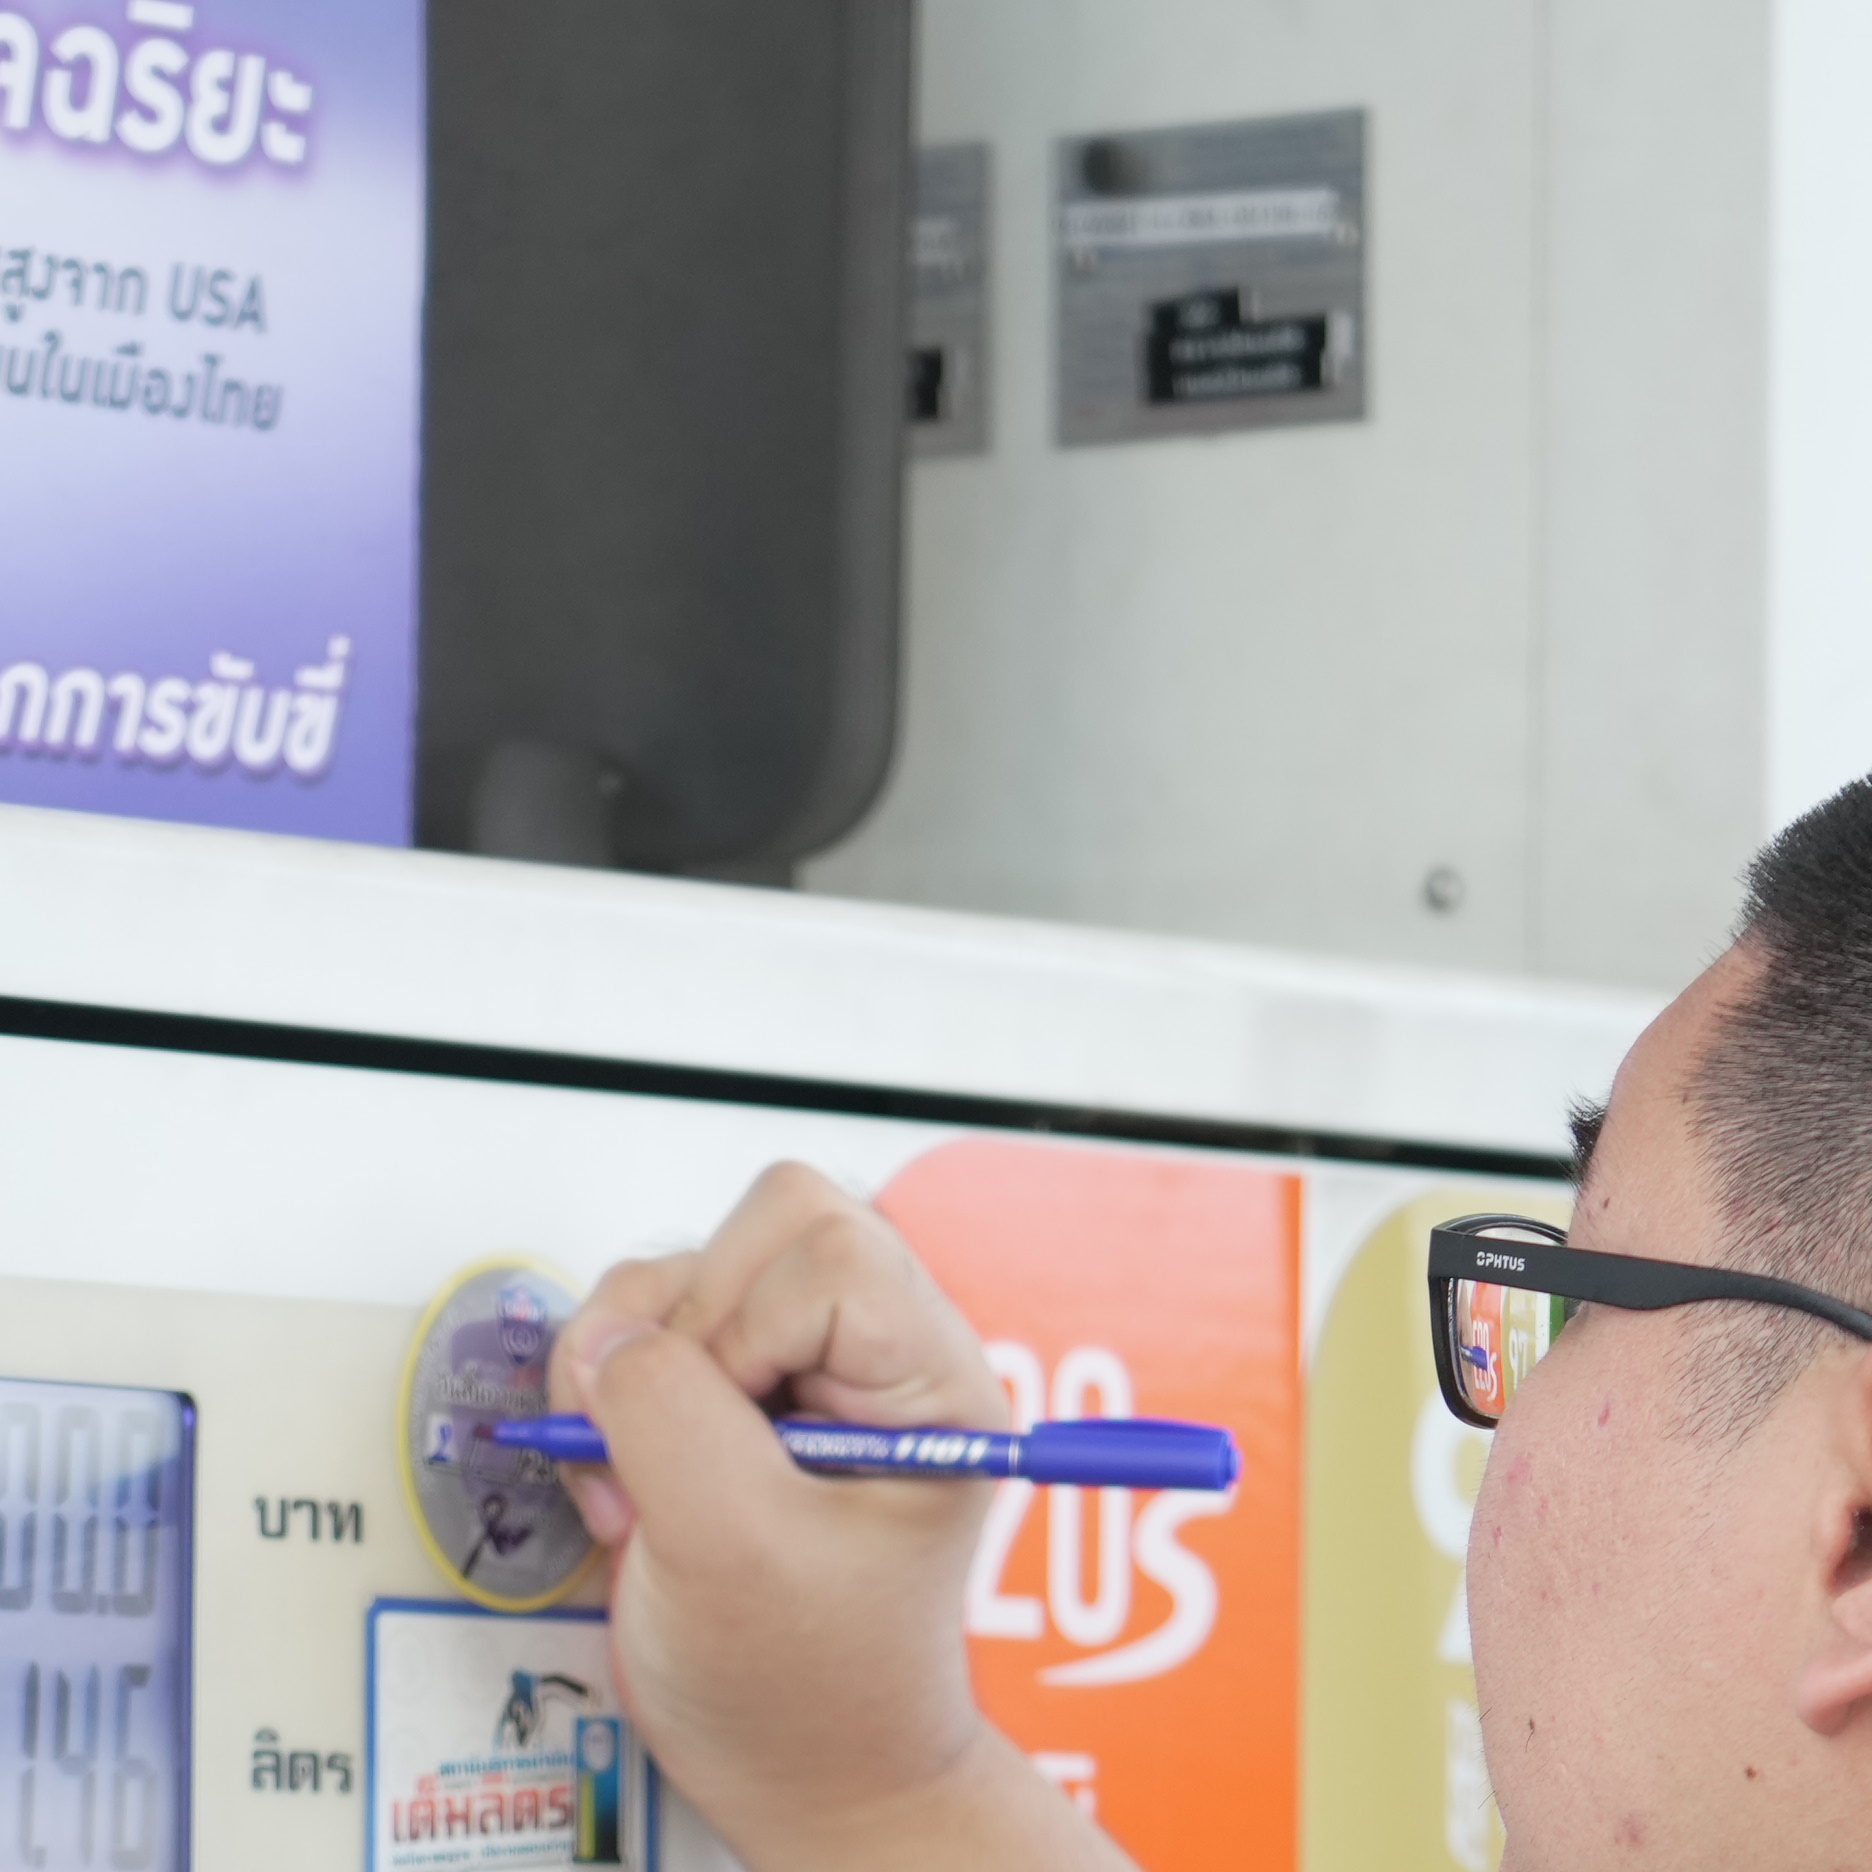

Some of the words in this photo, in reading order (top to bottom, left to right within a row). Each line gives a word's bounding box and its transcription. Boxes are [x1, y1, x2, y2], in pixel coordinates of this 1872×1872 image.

[168, 261, 270, 334] USA
[255, 1494, 365, 1544] บาท
[251, 1727, 354, 1794] ลิตร
